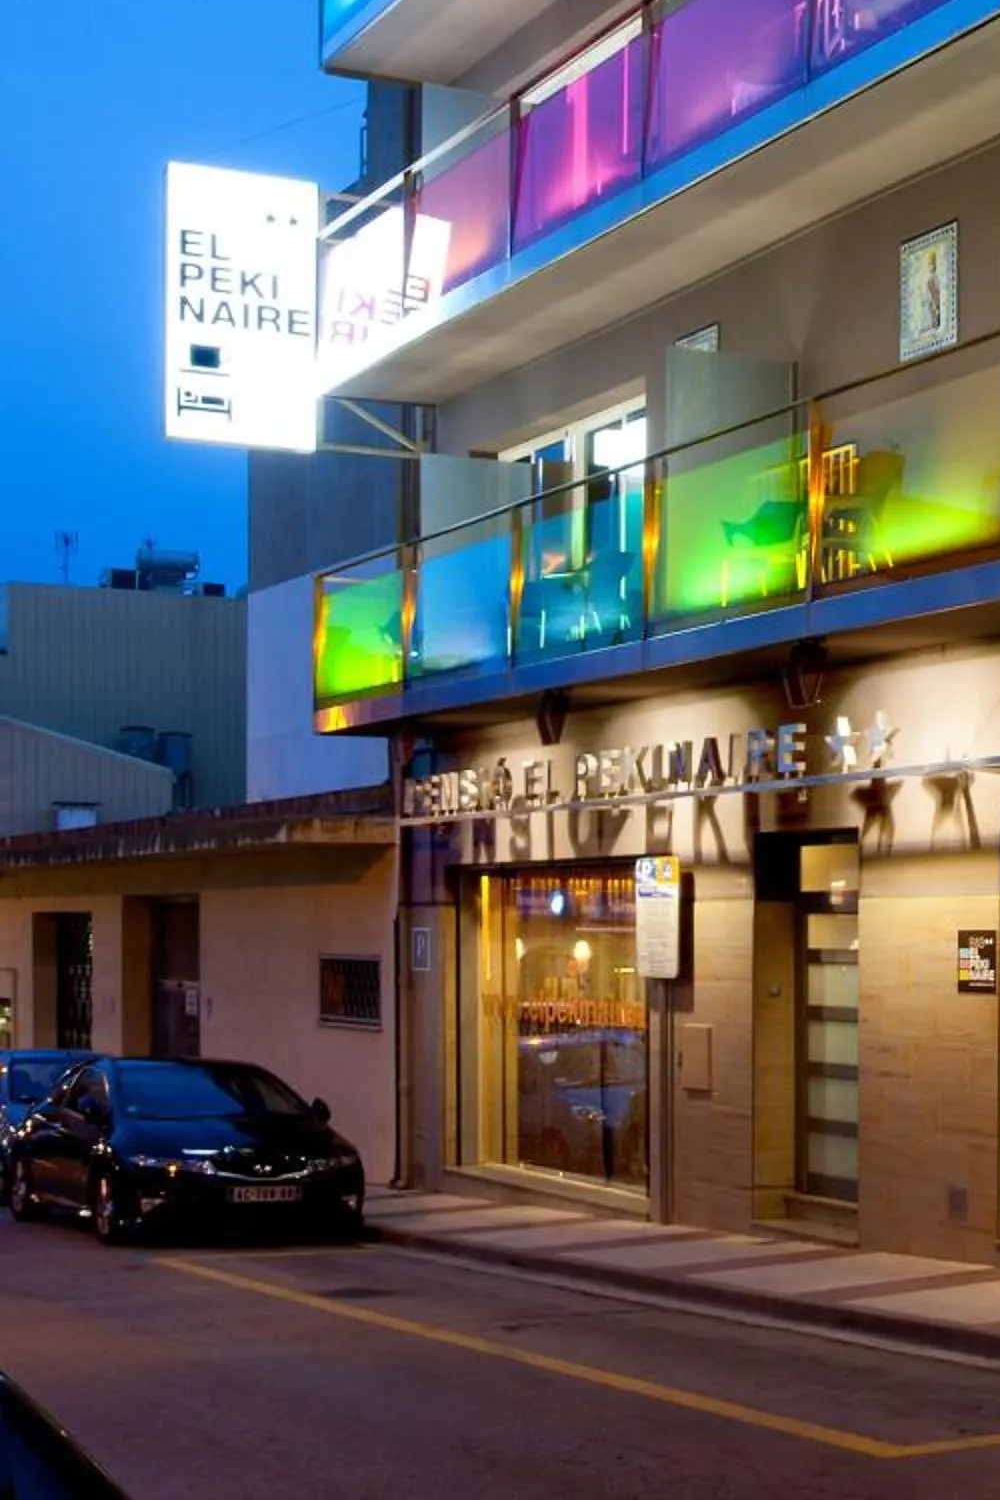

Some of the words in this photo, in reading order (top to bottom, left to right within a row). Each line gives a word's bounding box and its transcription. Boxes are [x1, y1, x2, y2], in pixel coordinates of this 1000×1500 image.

[179, 229, 231, 261] EL
[178, 262, 278, 300] PEKI
[178, 295, 312, 337] NAIRE
[521, 759, 560, 805] EL
[574, 723, 807, 802] PEKINAIRE
